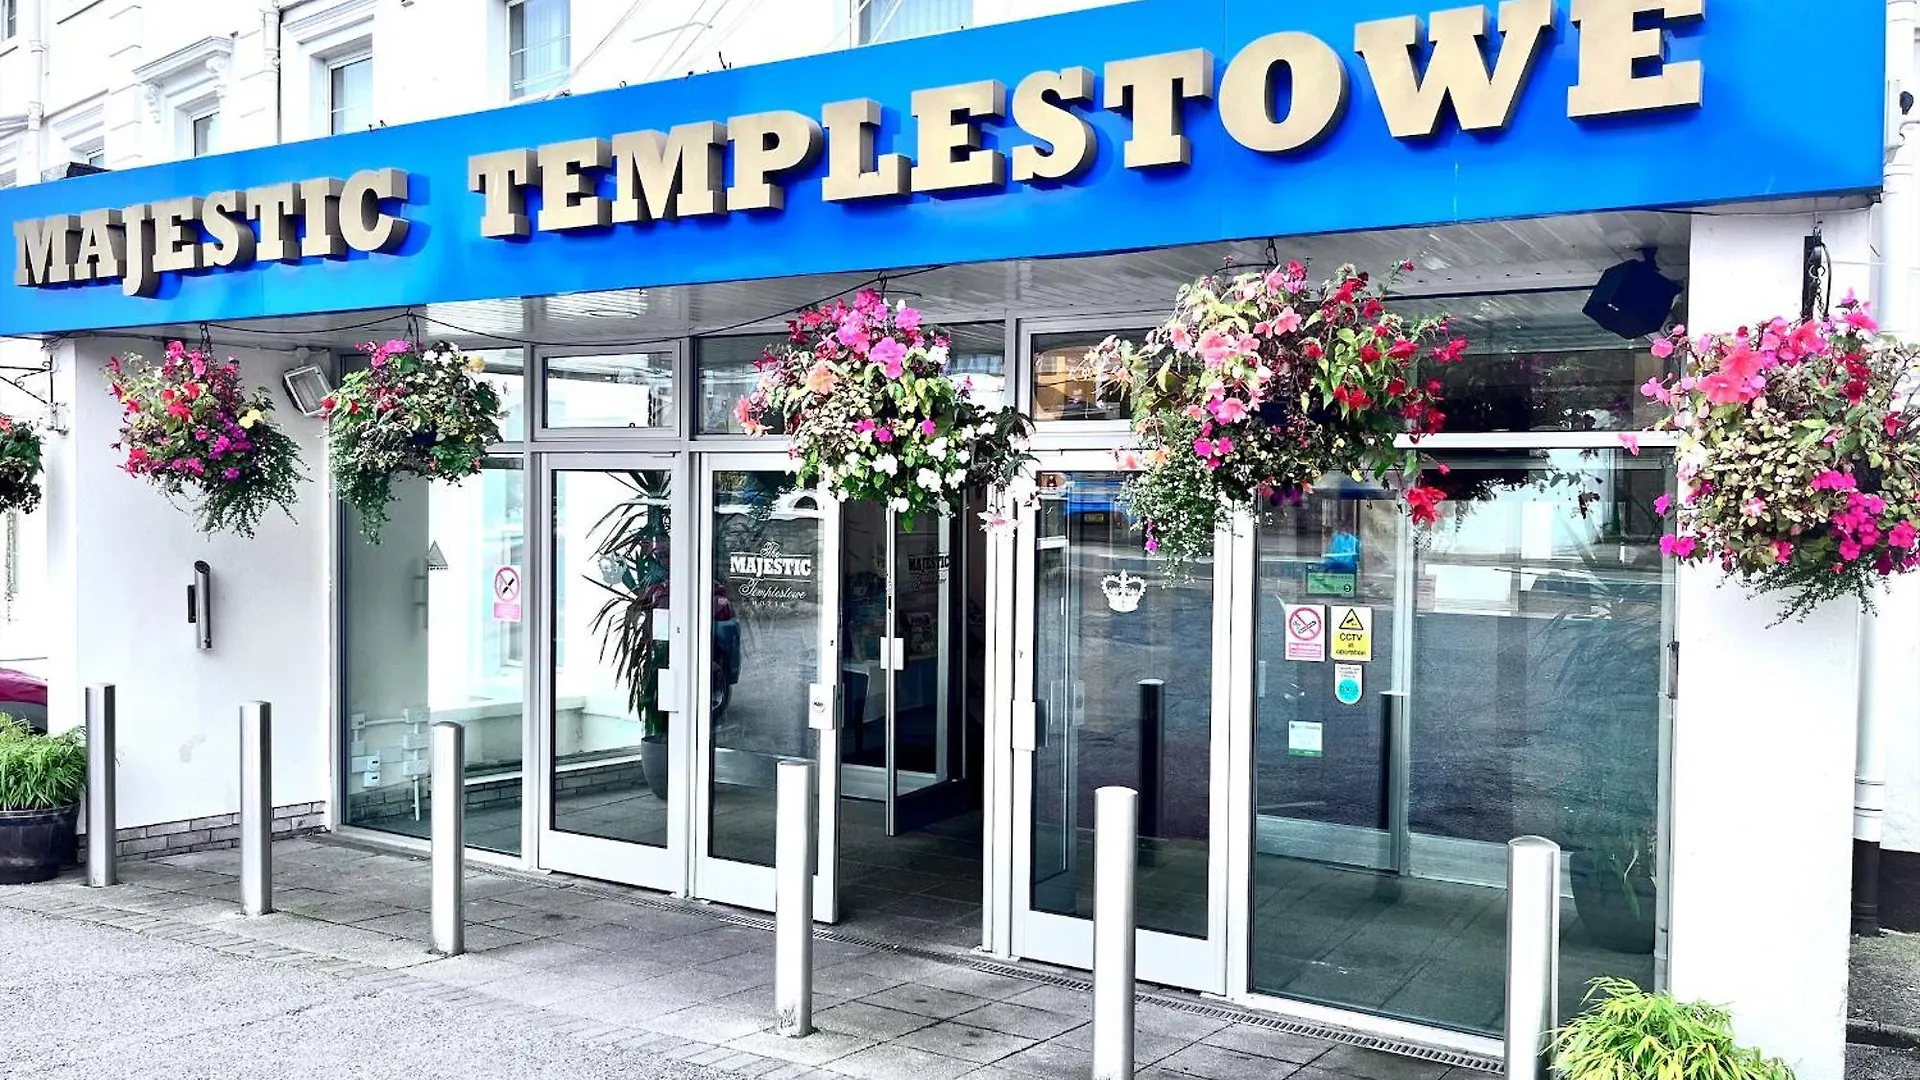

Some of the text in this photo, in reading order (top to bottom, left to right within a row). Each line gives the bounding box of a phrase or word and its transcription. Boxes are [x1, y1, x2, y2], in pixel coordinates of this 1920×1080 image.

[13, 0, 1705, 298] MAJESTIC TEMPLESTOWE
[760, 540, 782, 558] The
[729, 556, 812, 578] MAJESTIC
[738, 577, 807, 599] Templestowe
[1339, 632, 1363, 641] CCTV
